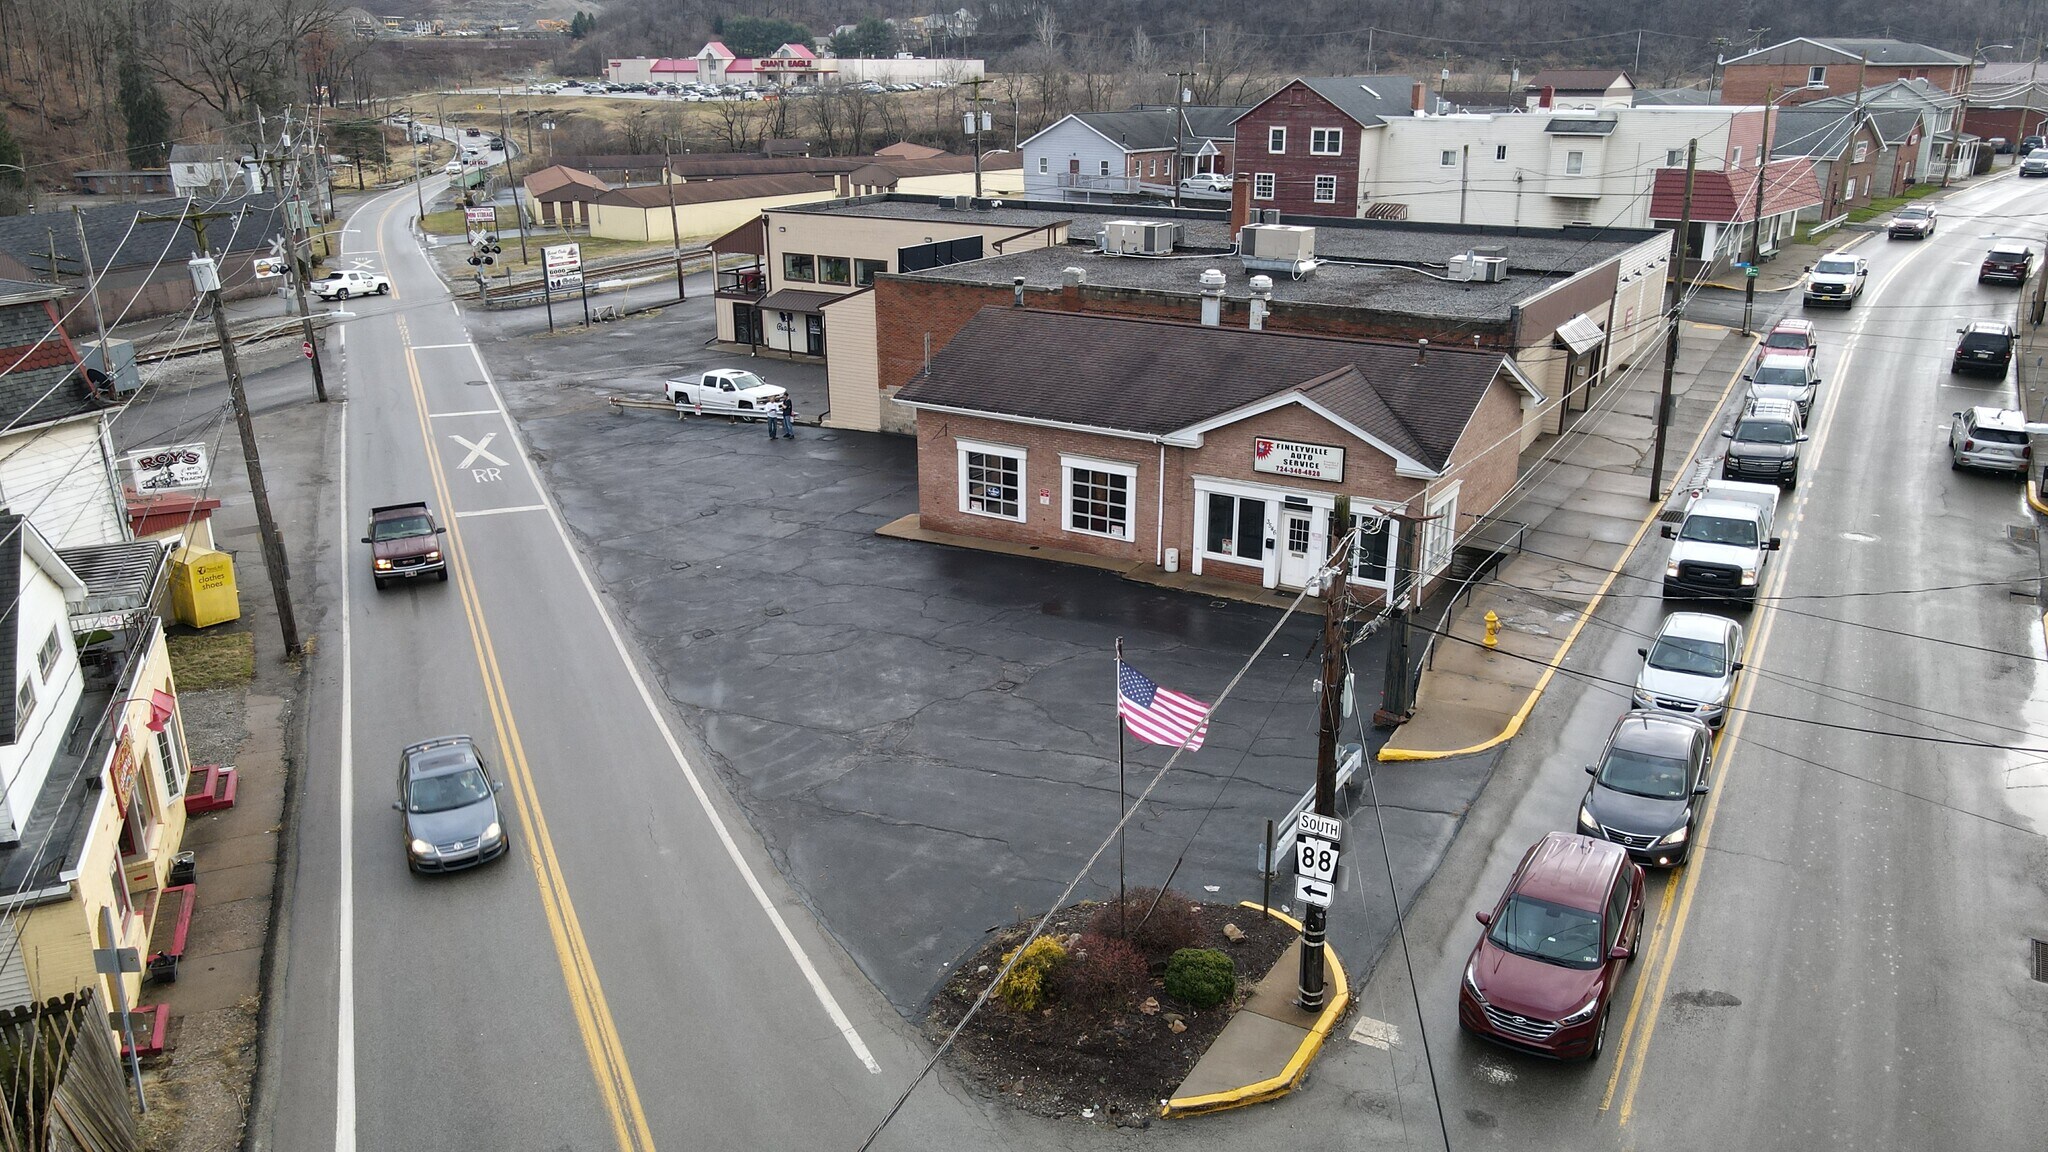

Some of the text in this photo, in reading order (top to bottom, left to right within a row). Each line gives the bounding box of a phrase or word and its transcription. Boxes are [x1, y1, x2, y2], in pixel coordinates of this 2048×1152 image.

[1276, 443, 1328, 456] FINLEYVILLE
[138, 450, 200, 470] ROY'S
[1290, 453, 1313, 461] AUTO
[1283, 459, 1320, 469] SERVICE
[471, 467, 502, 483] RR
[198, 573, 225, 584] clothes
[202, 581, 223, 590] shoes
[1301, 815, 1338, 836] SOUTH
[1302, 846, 1331, 872] 88
